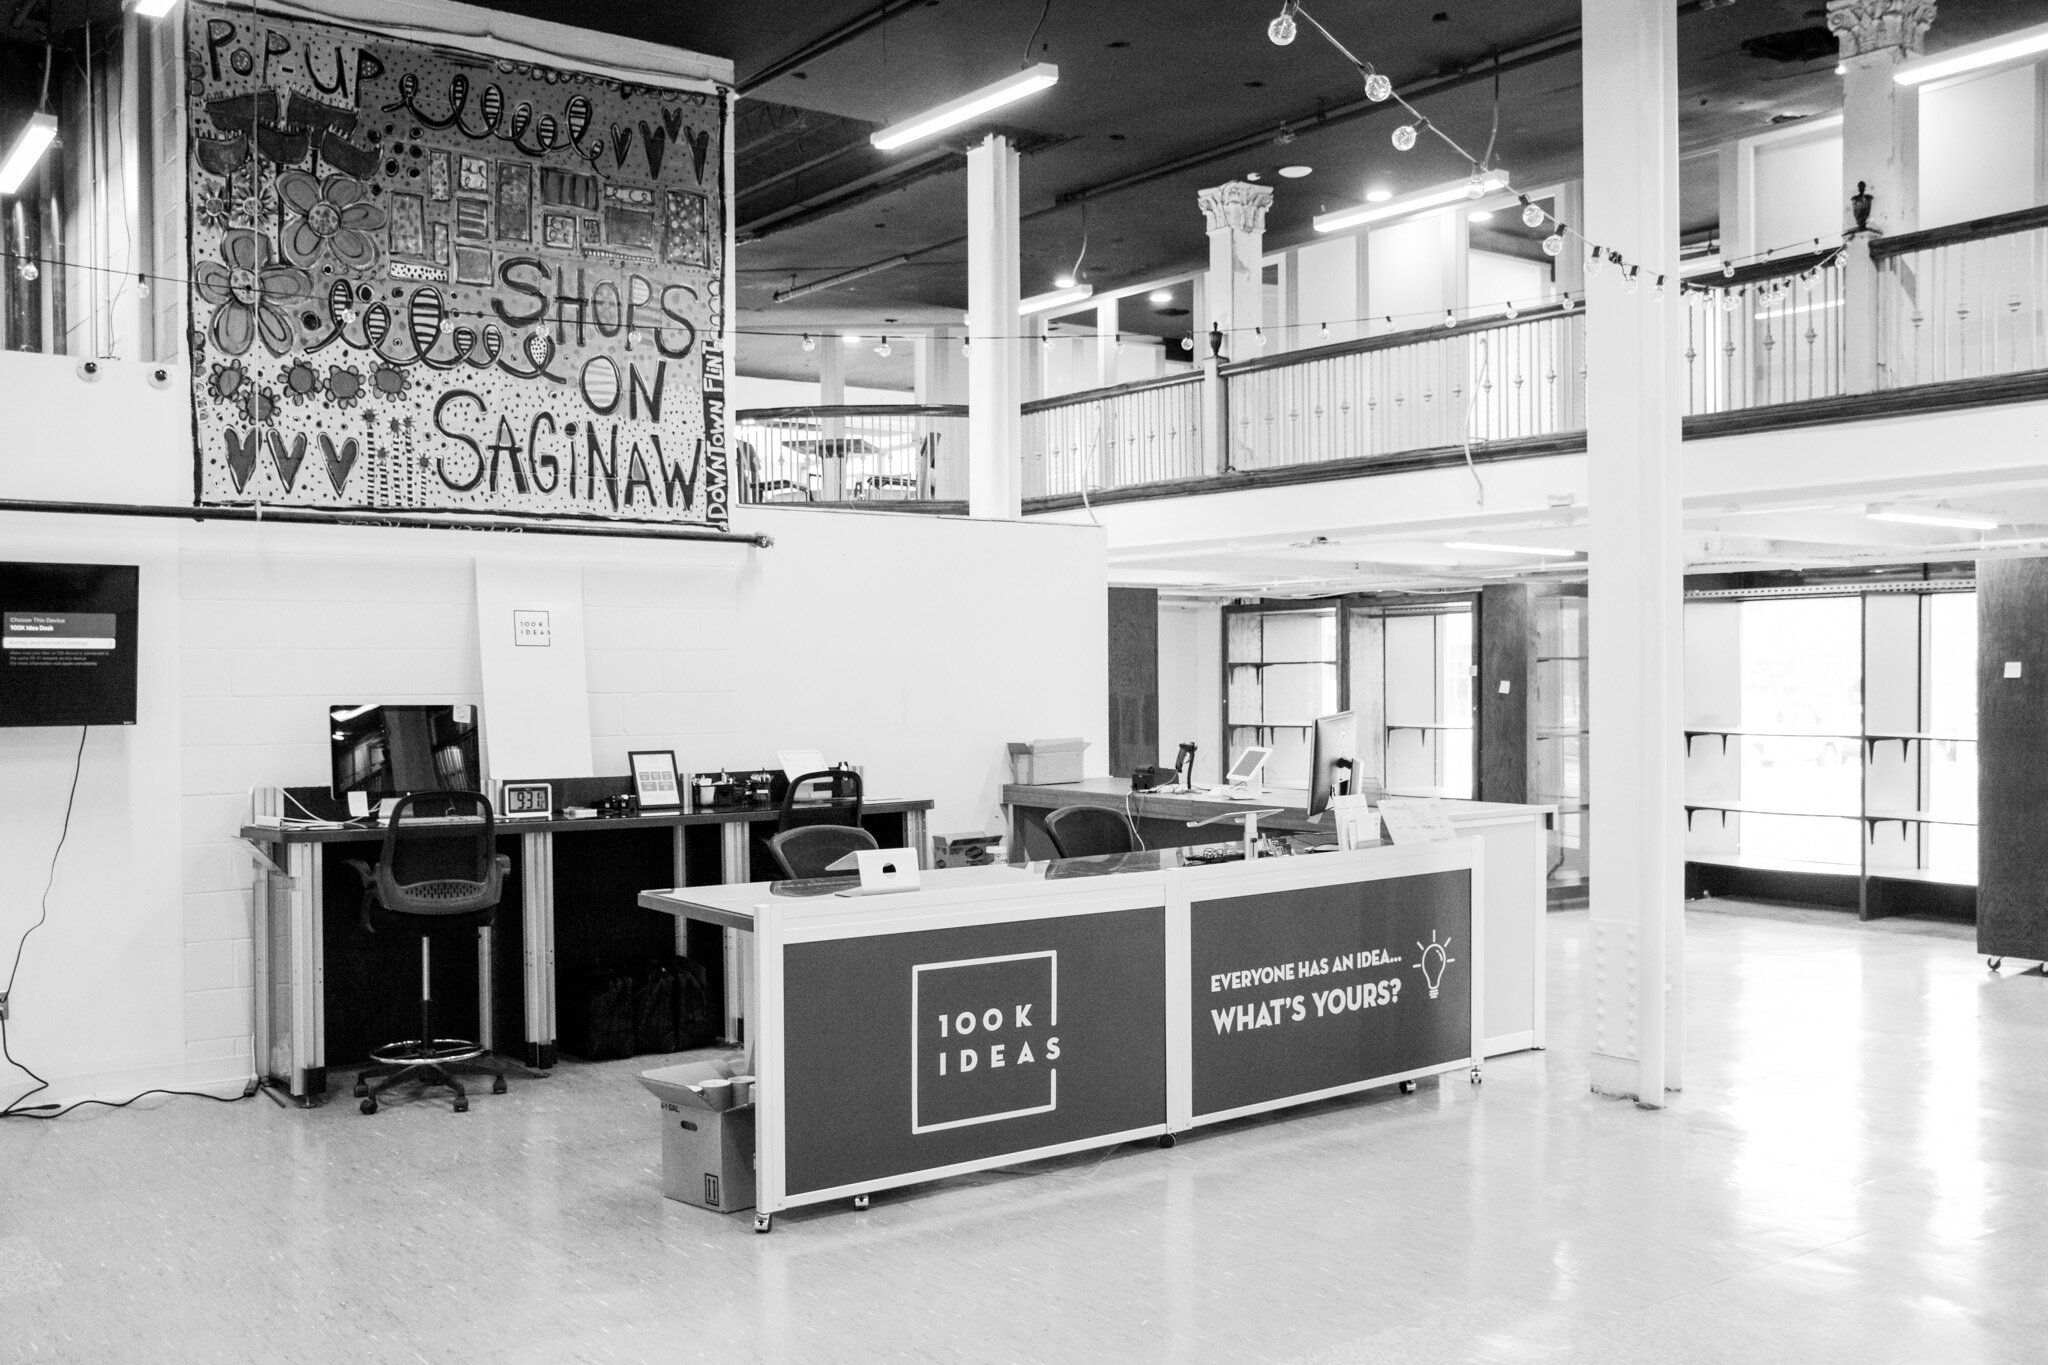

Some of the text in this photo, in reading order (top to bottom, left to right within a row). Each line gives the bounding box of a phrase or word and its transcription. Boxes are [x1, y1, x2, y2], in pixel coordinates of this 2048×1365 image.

[491, 256, 698, 359] SHOPS
[579, 354, 667, 424] ON
[1211, 963, 1295, 992] EVERYONE
[1298, 957, 1329, 979] HAS
[1332, 954, 1354, 973] AN
[1211, 977, 1401, 1035] WHAT'S YOURS?
[939, 1037, 1061, 1075] IDEAS
